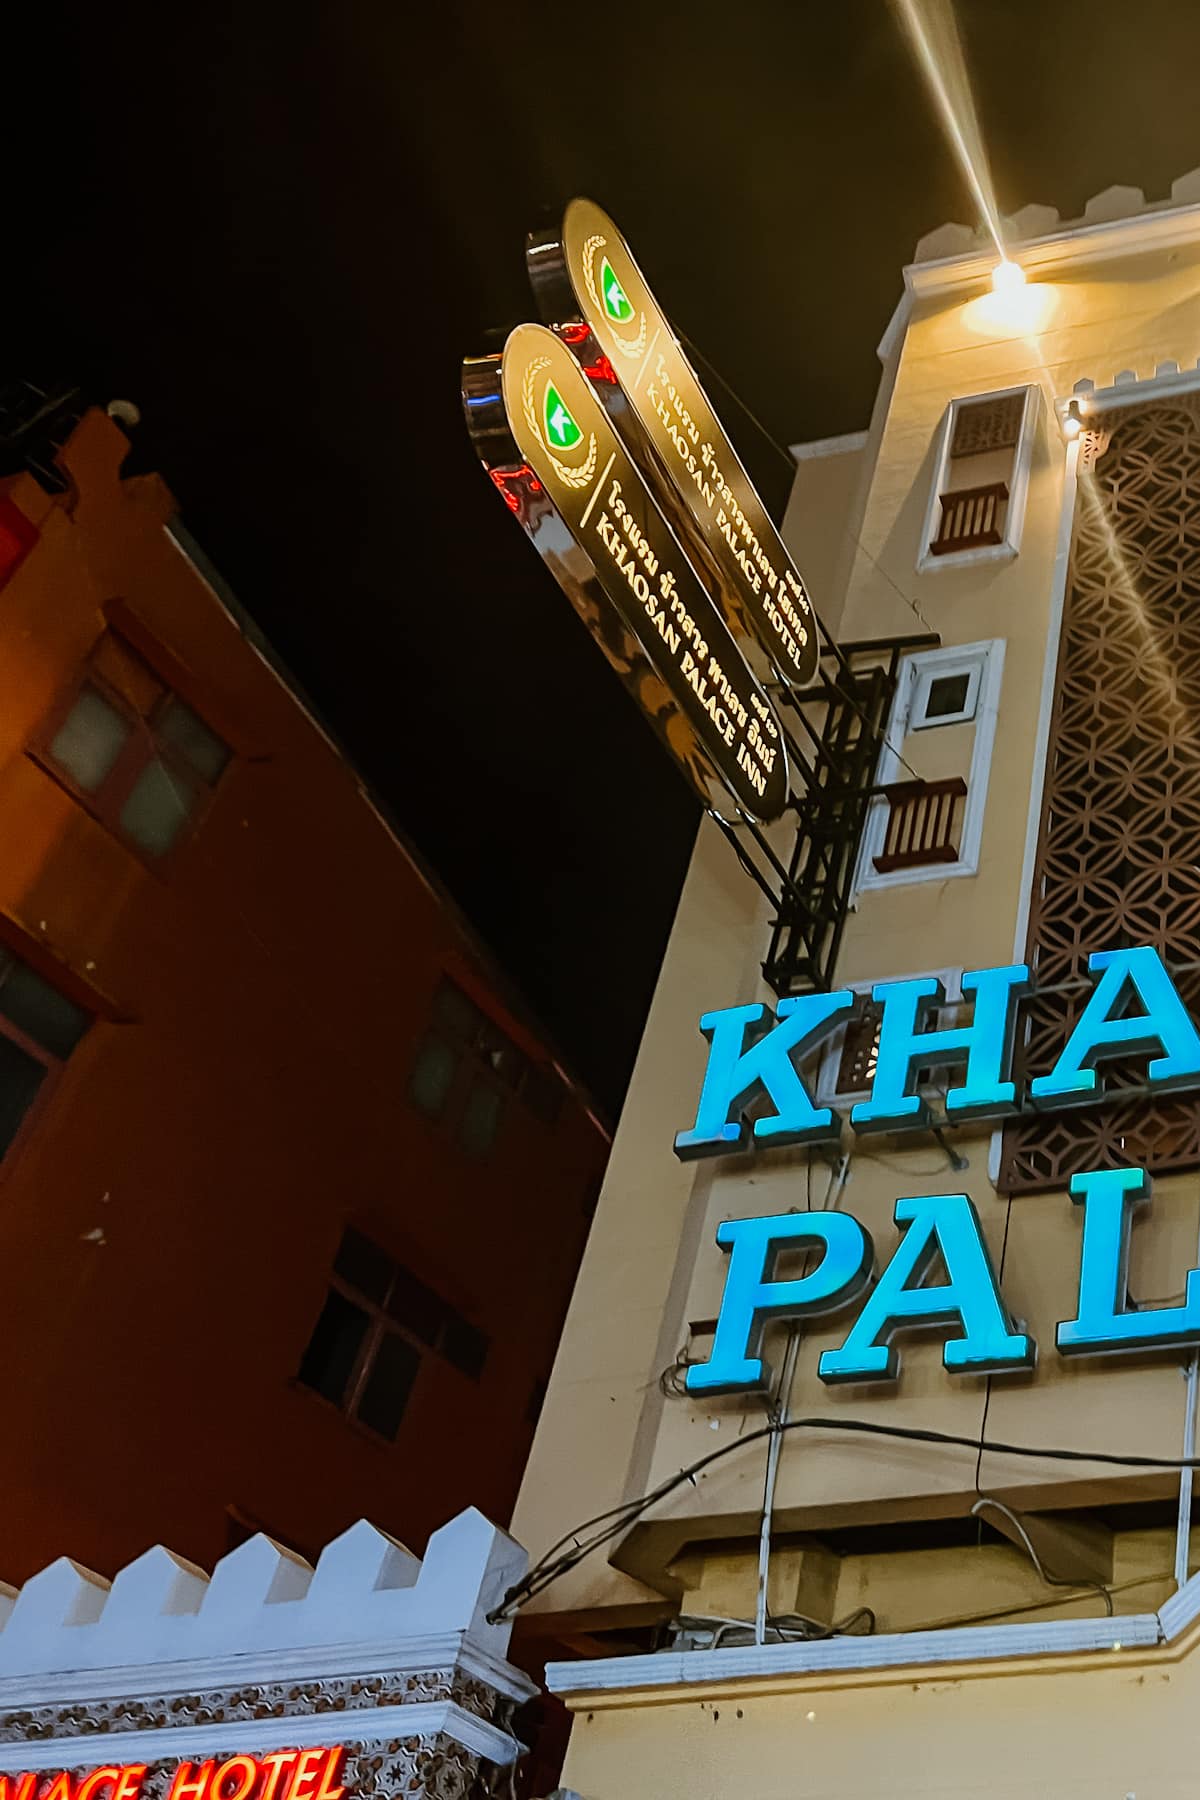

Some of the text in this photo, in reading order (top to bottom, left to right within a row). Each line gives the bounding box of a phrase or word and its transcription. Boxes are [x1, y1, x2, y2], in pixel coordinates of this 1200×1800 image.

[647, 383, 801, 670] KHAOSAN PALACE HOTEL
[656, 352, 700, 445] โรงแรม
[596, 511, 767, 797] KHAOSAN PALACE INN
[608, 479, 777, 773] โรงแรม ข้าวสาร พาเลซ อินน์
[170, 1746, 348, 1800] HOTEL
